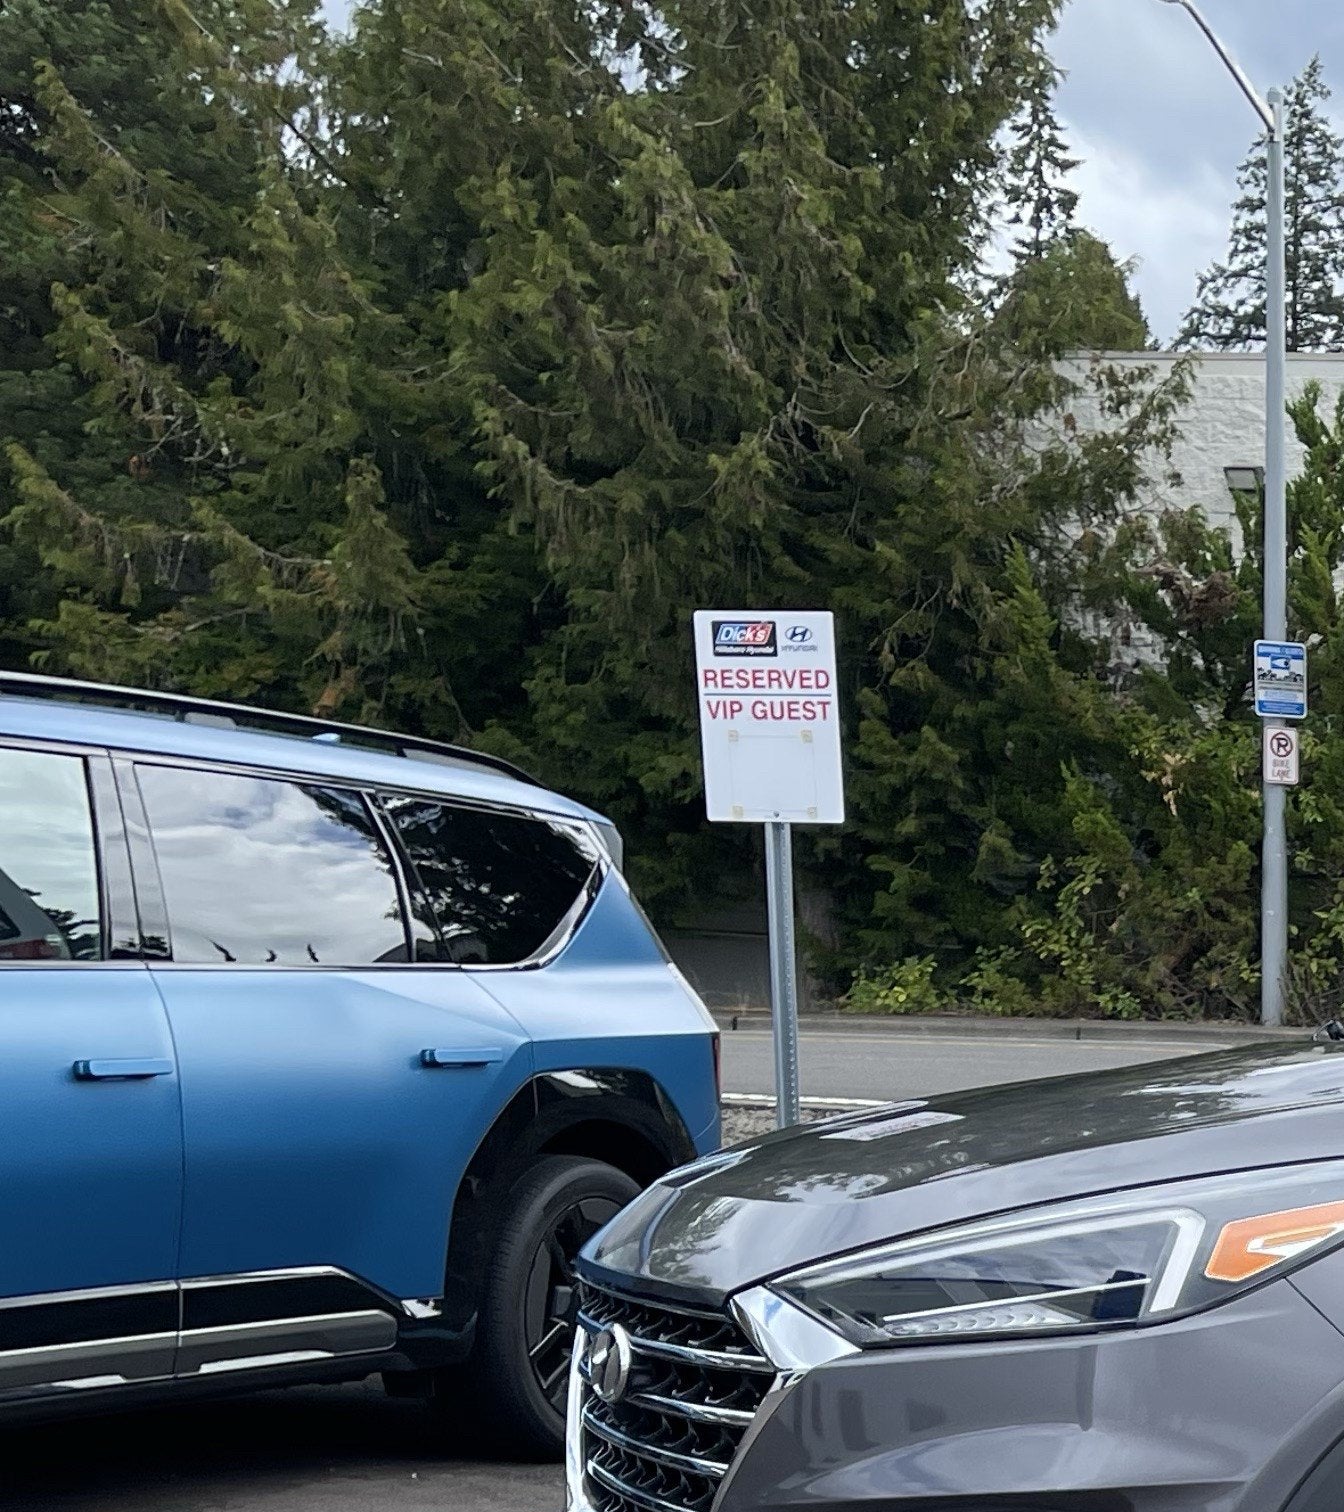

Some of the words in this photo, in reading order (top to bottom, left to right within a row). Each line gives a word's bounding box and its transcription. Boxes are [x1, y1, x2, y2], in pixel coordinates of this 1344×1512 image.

[703, 669, 831, 690] RESERVED
[706, 700, 743, 720] VIP
[751, 700, 832, 721] GUEST
